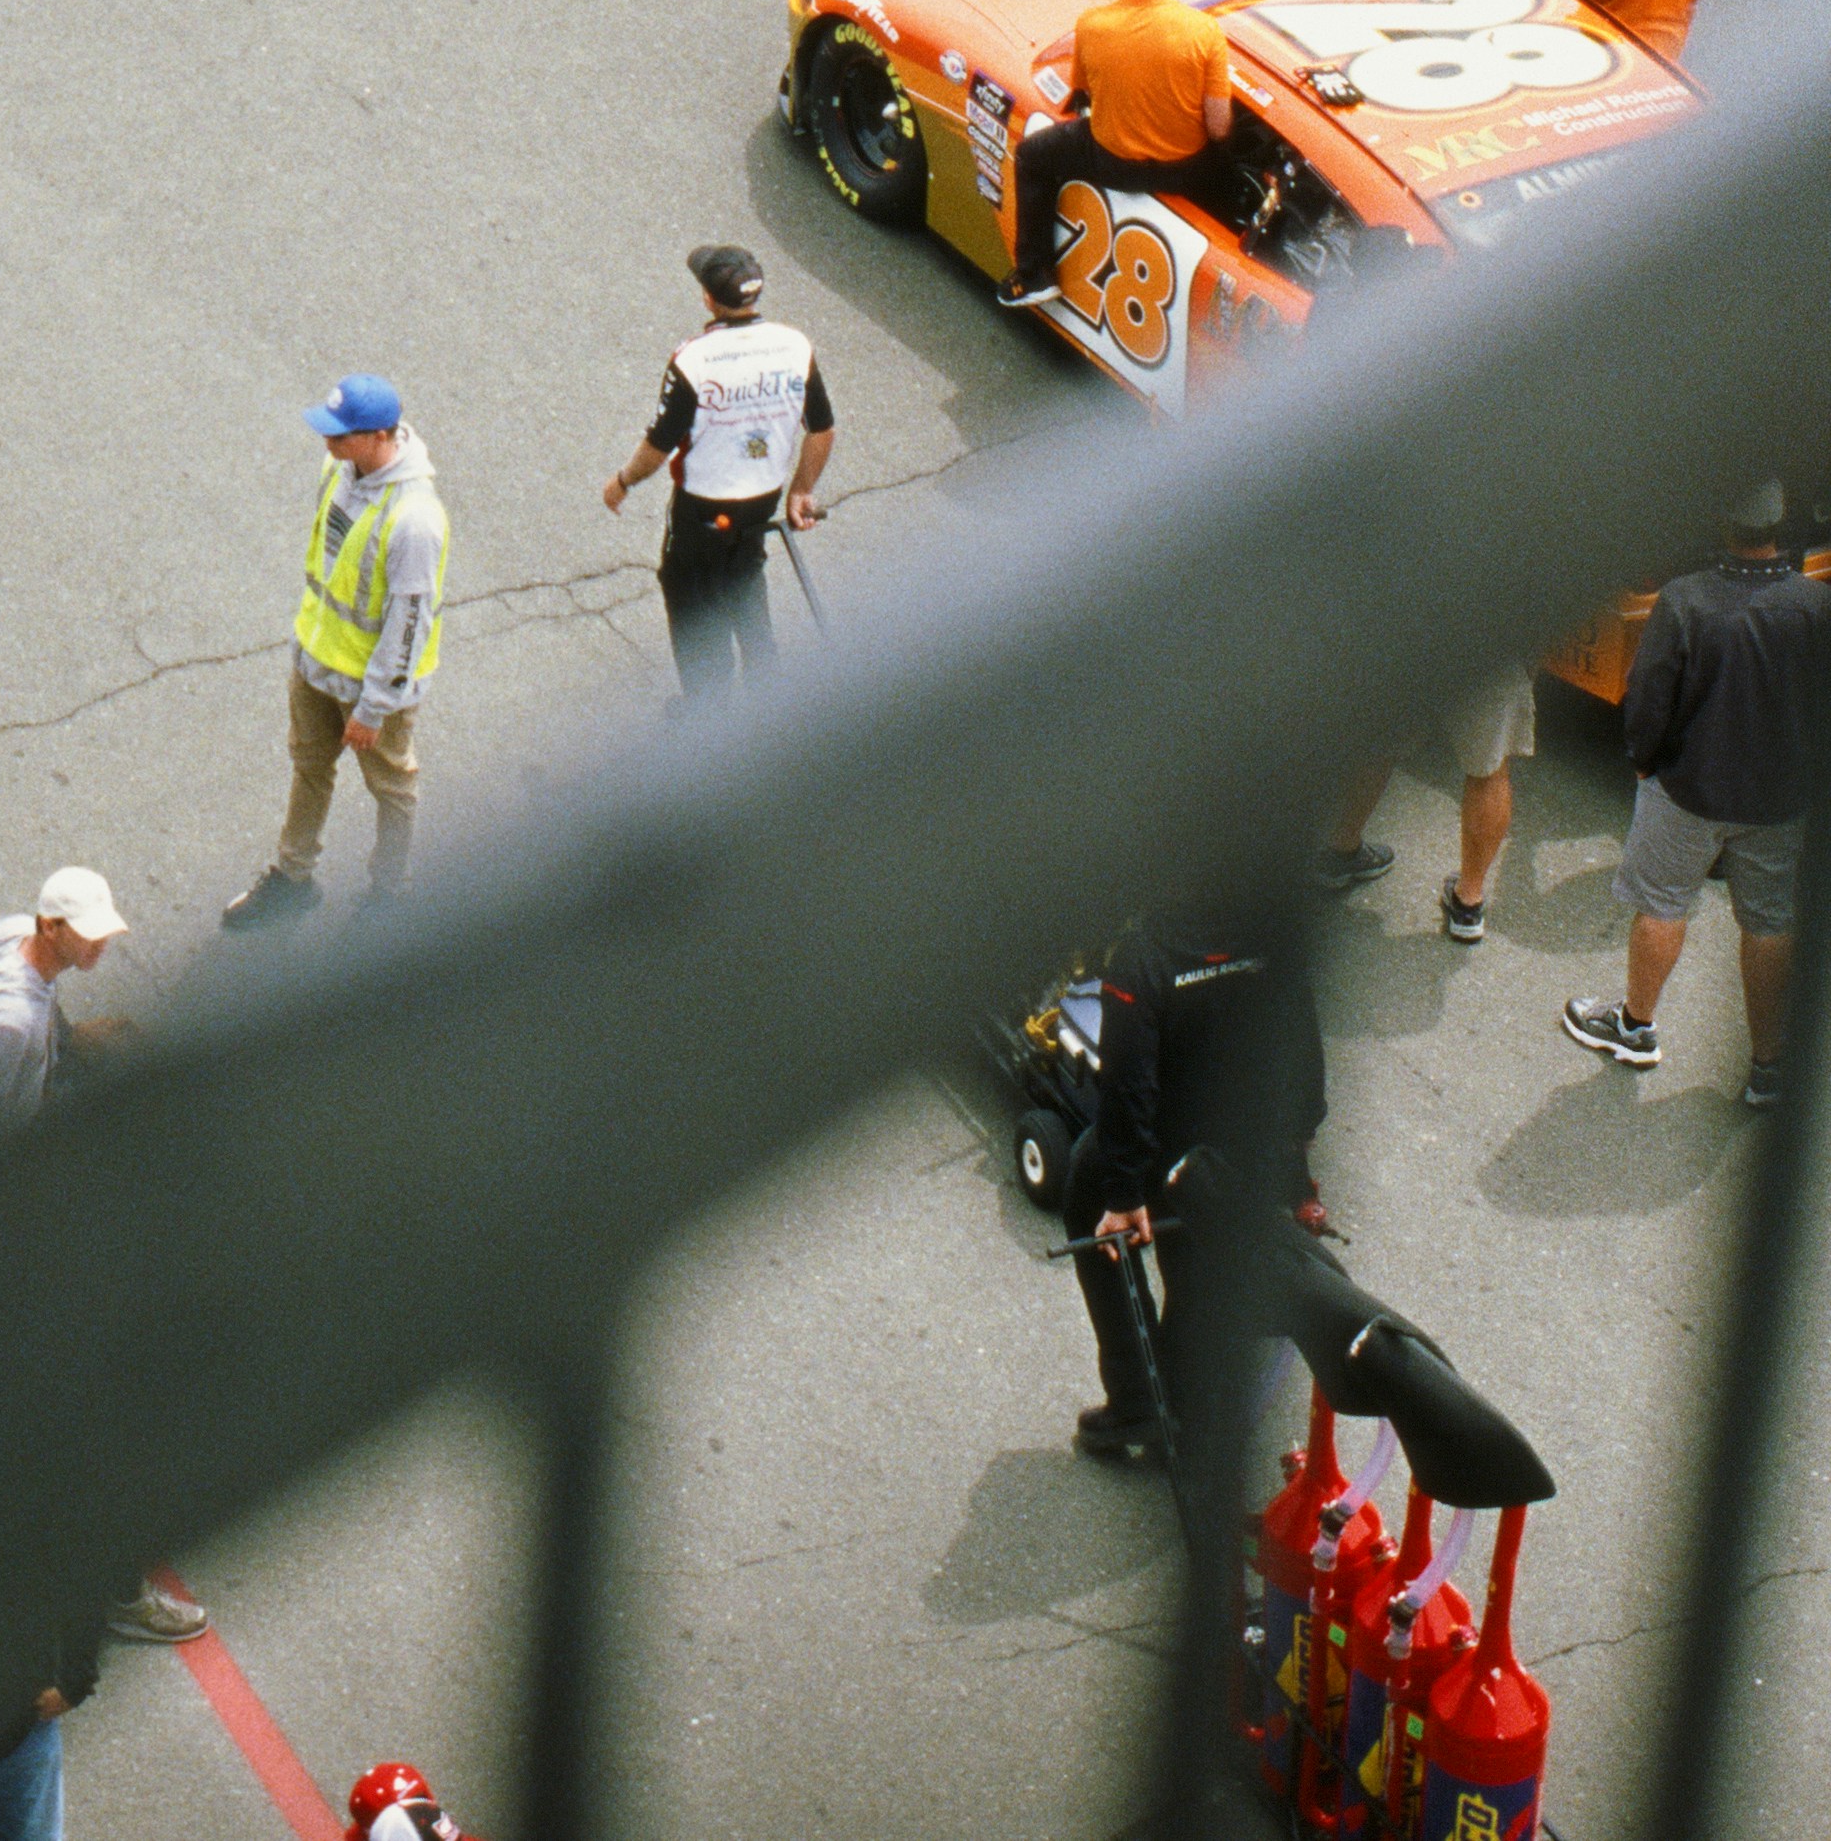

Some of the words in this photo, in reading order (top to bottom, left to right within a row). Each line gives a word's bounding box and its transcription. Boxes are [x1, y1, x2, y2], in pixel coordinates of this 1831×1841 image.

[1405, 117, 1544, 184] MRC
[1522, 96, 1608, 127] Michael
[1607, 84, 1690, 111] Roberts
[1552, 98, 1689, 138] Construction
[1056, 180, 1179, 367] 28
[1174, 964, 1218, 988] KAULIG
